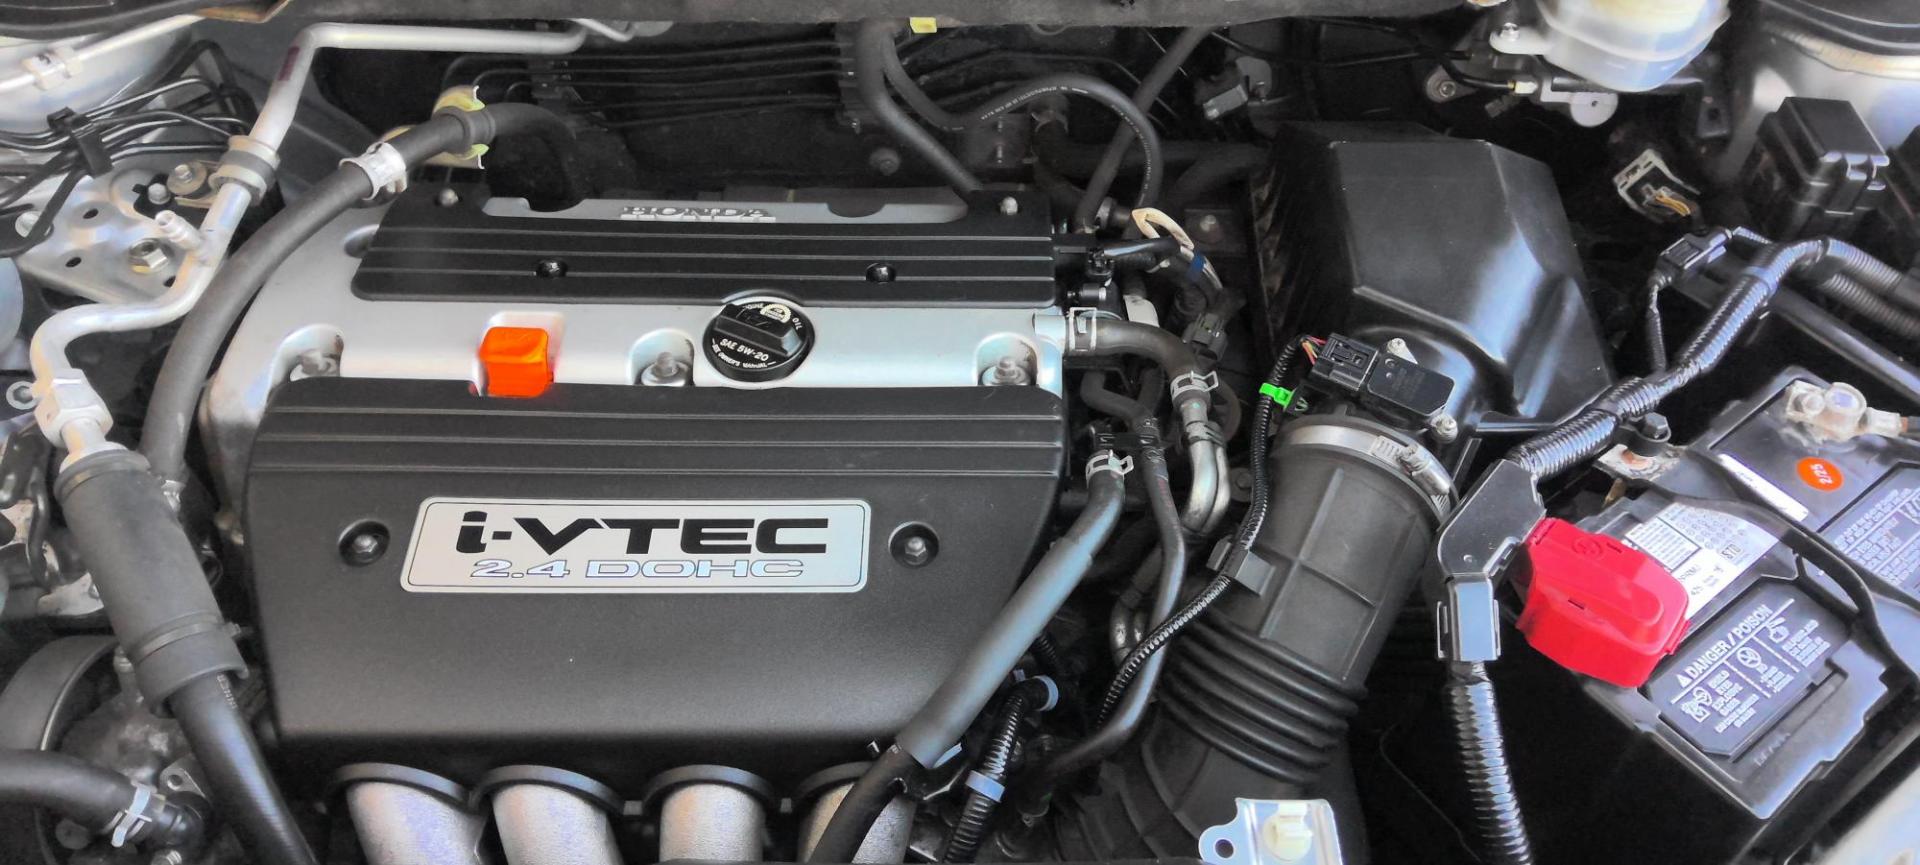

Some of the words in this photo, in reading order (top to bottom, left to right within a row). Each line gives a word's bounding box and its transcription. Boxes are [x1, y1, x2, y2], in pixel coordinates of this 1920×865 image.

[620, 206, 777, 224] HONDA
[791, 317, 803, 331] OIL
[719, 338, 738, 350] SAE
[737, 345, 769, 362] 5W-20
[455, 510, 829, 556] i-VTEC
[470, 559, 571, 579] 2.4
[585, 559, 803, 579] DOHC
[1685, 639, 1732, 679] DANGER
[1733, 604, 1773, 639] POISON
